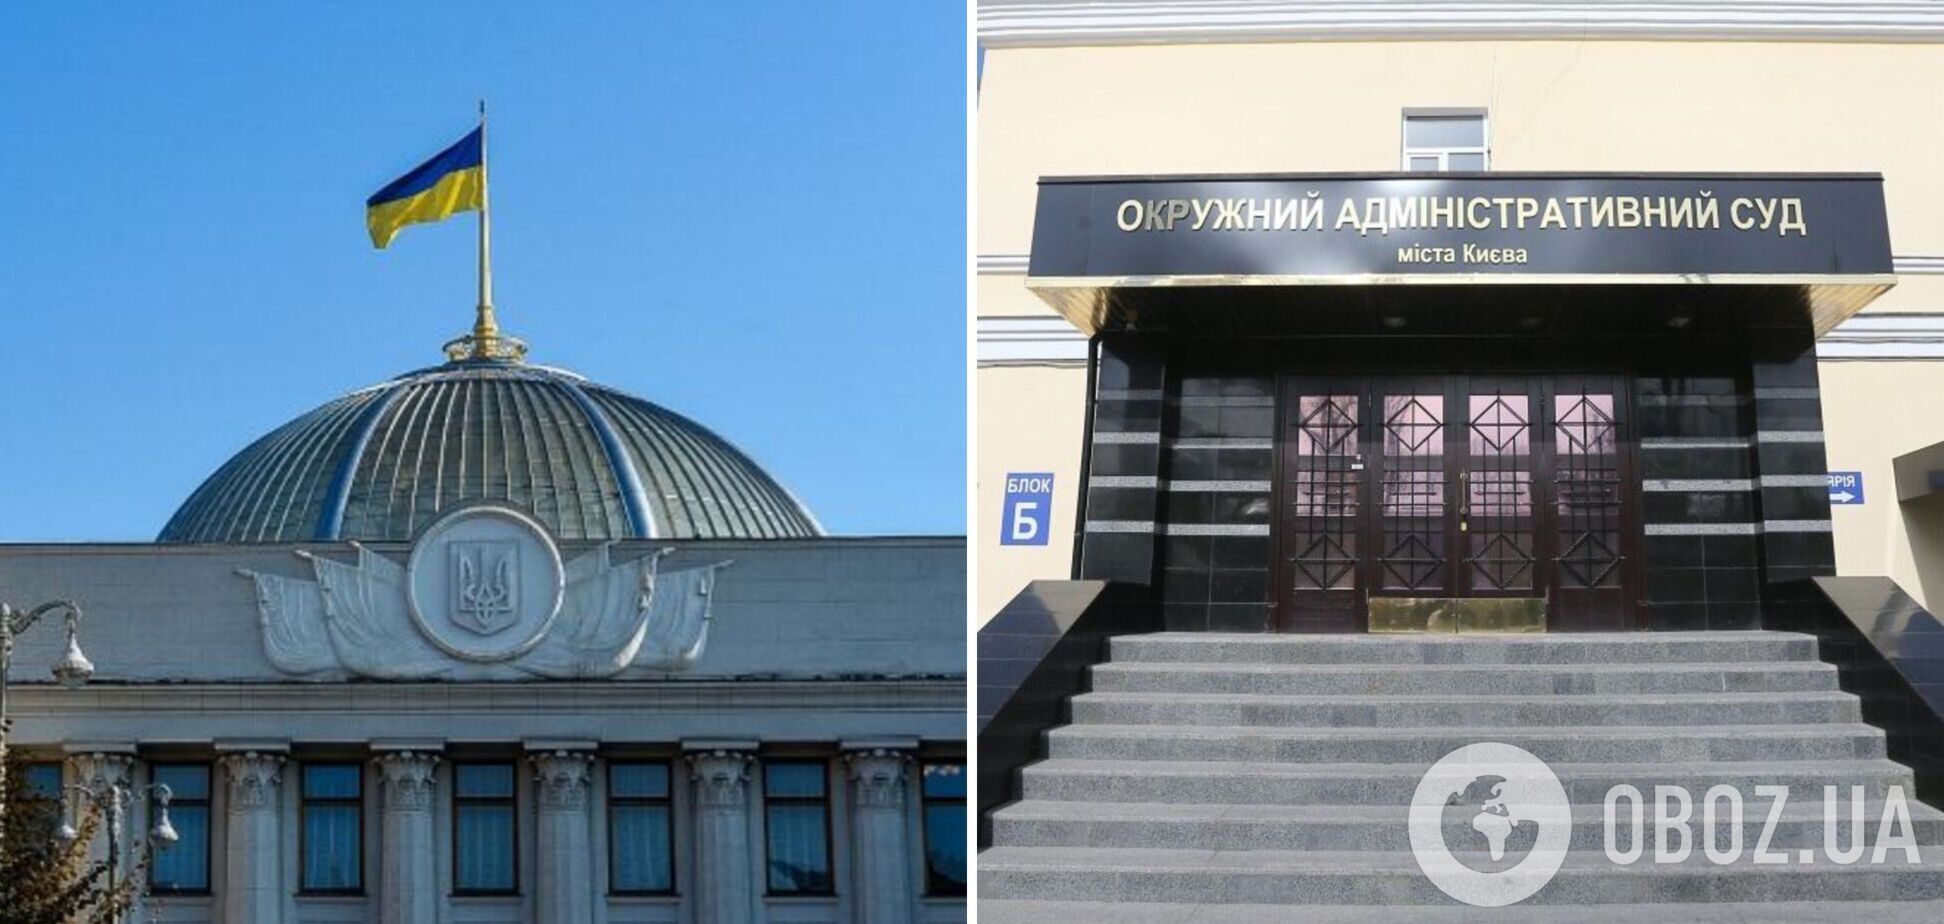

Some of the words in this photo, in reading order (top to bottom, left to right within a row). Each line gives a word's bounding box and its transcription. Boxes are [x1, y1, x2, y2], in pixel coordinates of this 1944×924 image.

[1117, 190, 1324, 231] ОКРУЖНИЙ
[1335, 190, 1719, 236] АДМІНІСТРАТИВНИЙ
[1730, 197, 1807, 236] СУД
[1398, 243, 1455, 263] міста
[1463, 243, 1528, 263] Києва
[1007, 478, 1051, 493] БЛОК
[1012, 502, 1038, 540] Б
